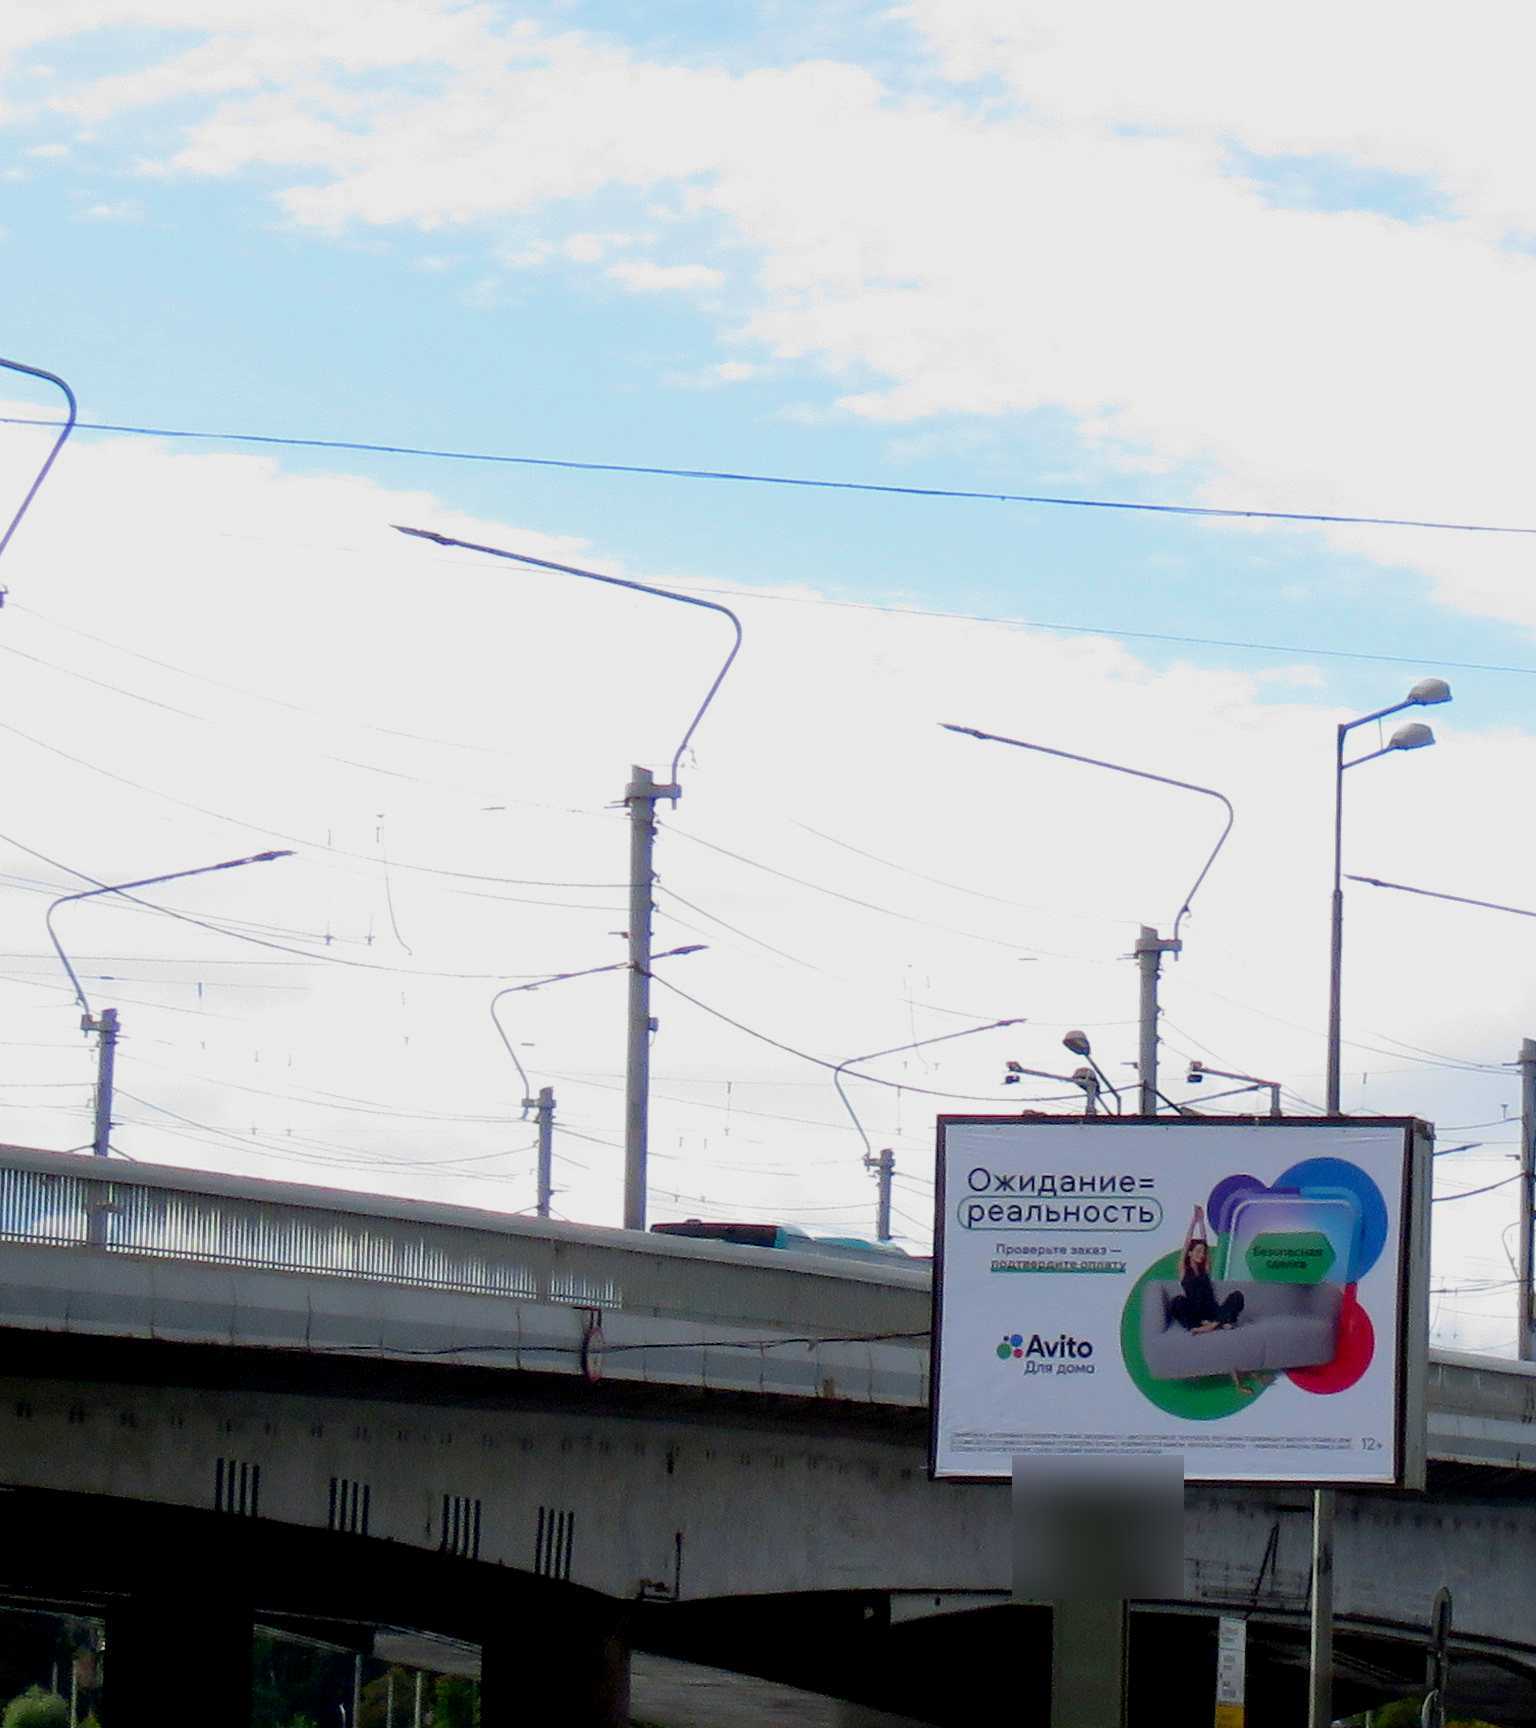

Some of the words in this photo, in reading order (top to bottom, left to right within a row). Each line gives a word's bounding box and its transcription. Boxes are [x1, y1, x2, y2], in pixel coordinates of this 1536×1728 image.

[968, 1203, 1155, 1228] реальность
[995, 1243, 1067, 1257] Проверьте
[1071, 1246, 1107, 1256] заказ
[1024, 1334, 1093, 1358] Avito
[1024, 1360, 1053, 1375] Для
[1056, 1363, 1095, 1375] дома
[1360, 1437, 1383, 1451] 12+
